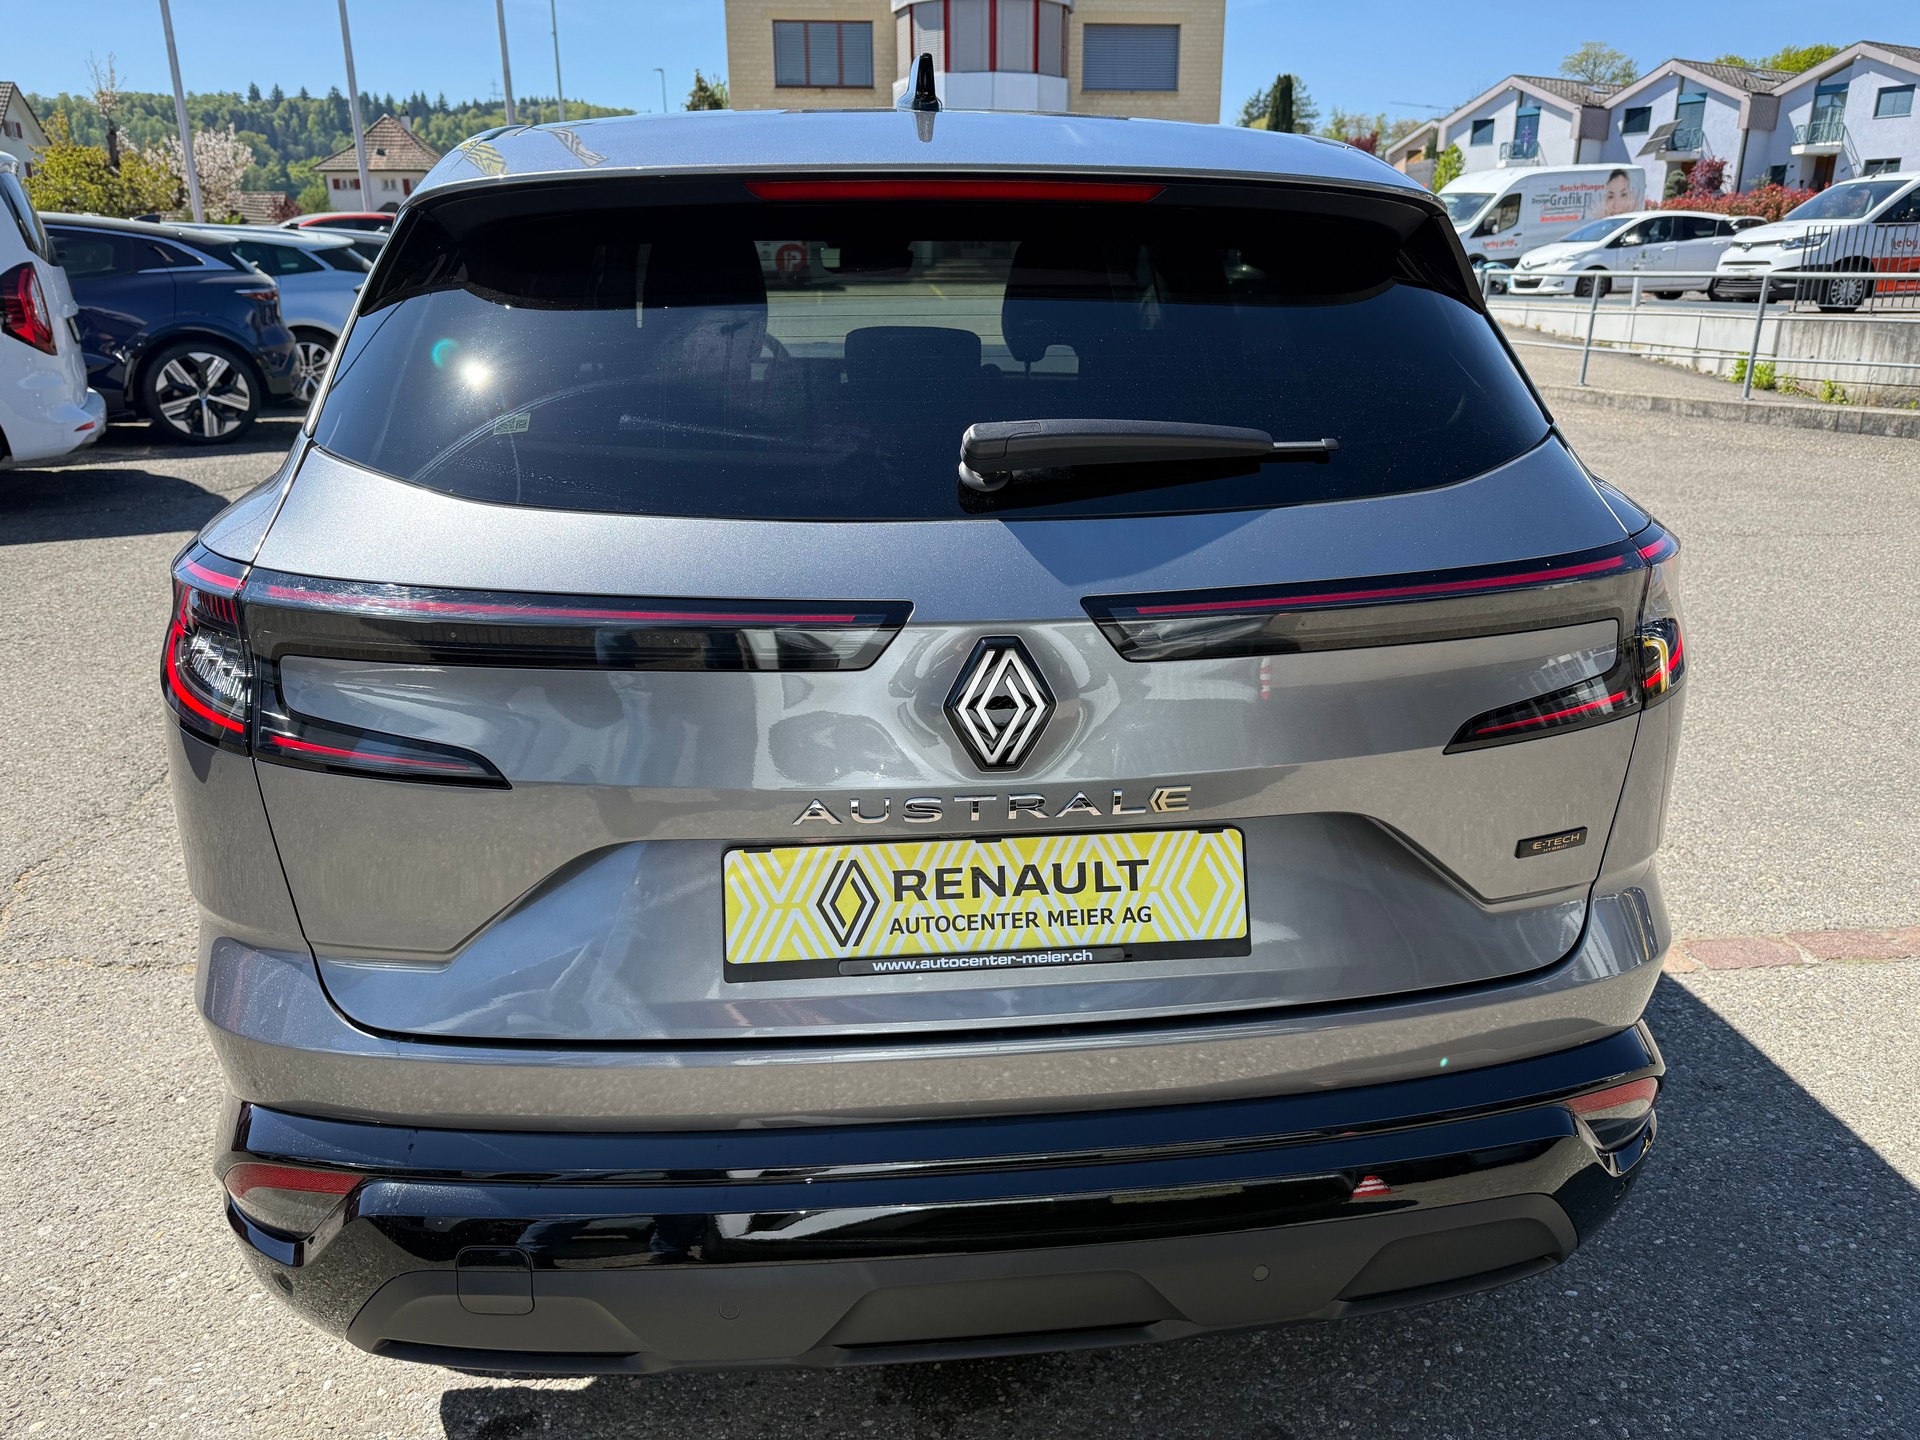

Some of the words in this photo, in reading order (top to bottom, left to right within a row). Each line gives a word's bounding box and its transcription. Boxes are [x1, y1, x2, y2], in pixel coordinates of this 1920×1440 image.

[1550, 192, 1582, 206] Grafik
[791, 785, 1192, 826] AUSTRALE
[1532, 833, 1580, 850] E-TECH
[892, 859, 1150, 902] RENAULT
[888, 911, 1039, 936] AUTOCENTER
[1047, 908, 1114, 926] MEIER
[1121, 905, 1152, 924] AG
[872, 949, 1093, 972] www.autocenter-meier.ch
